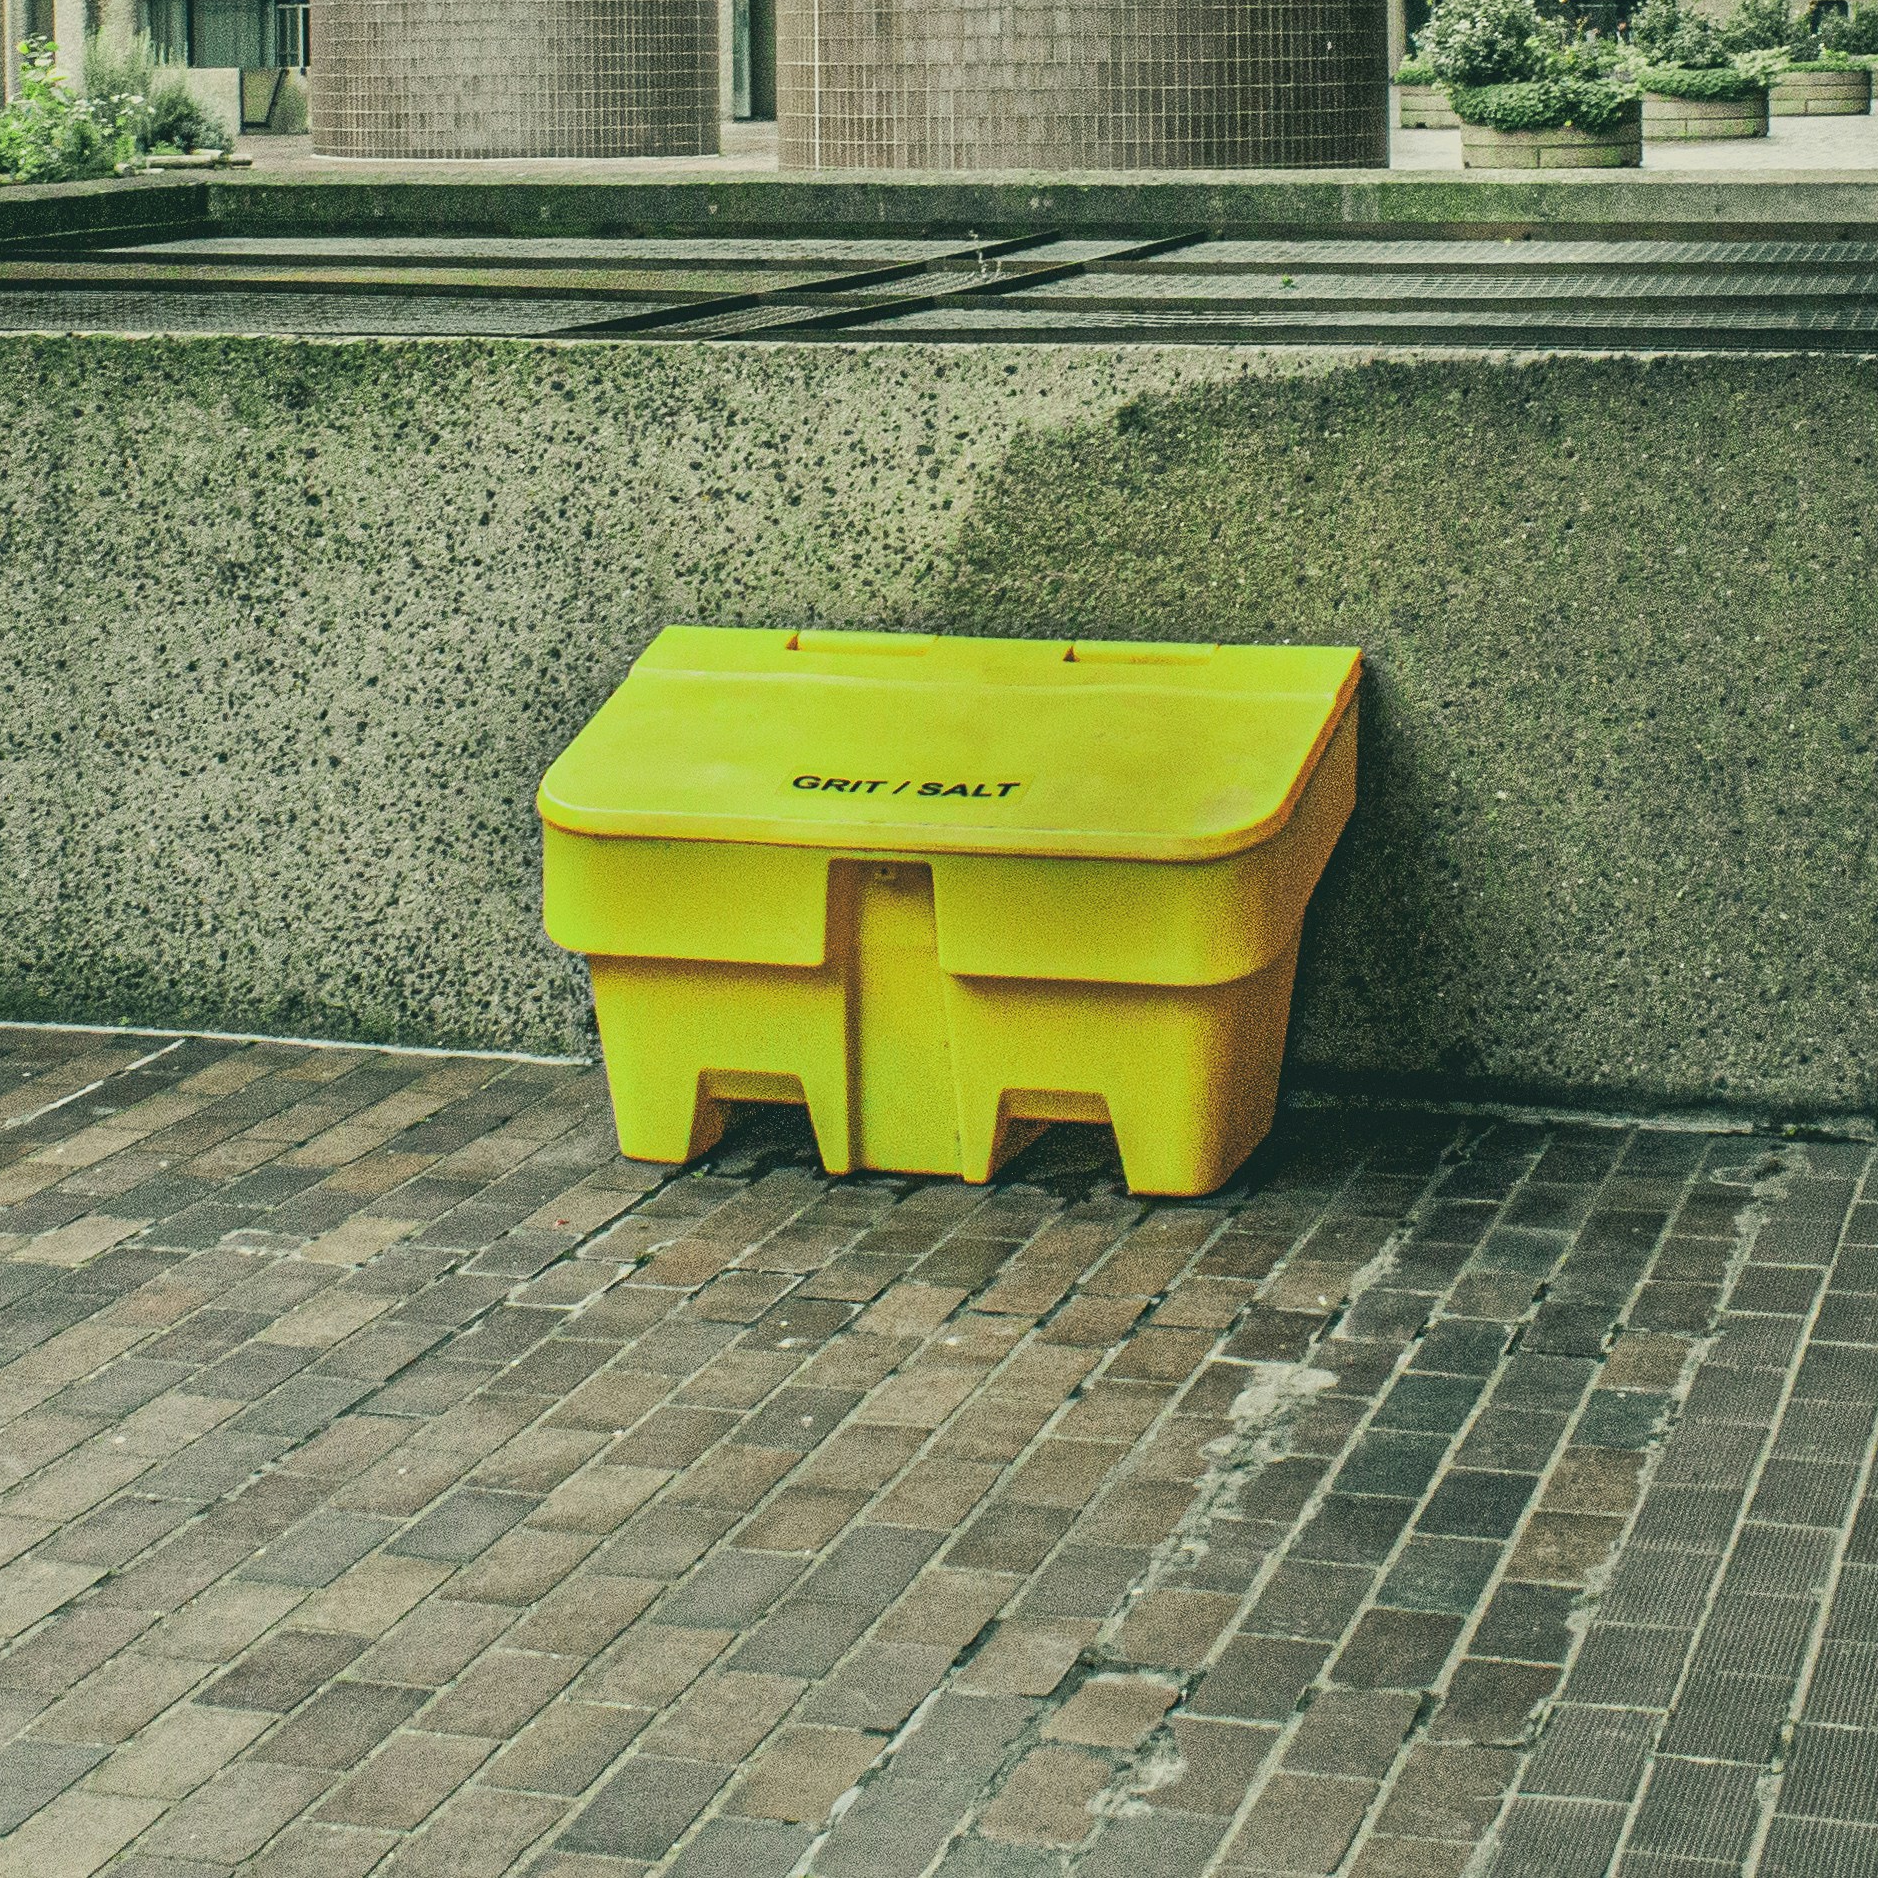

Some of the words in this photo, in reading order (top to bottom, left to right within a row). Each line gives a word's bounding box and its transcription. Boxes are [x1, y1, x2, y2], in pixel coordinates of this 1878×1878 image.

[793, 775, 888, 794] GRIT
[892, 781, 911, 795] /
[917, 782, 1021, 797] SALT
